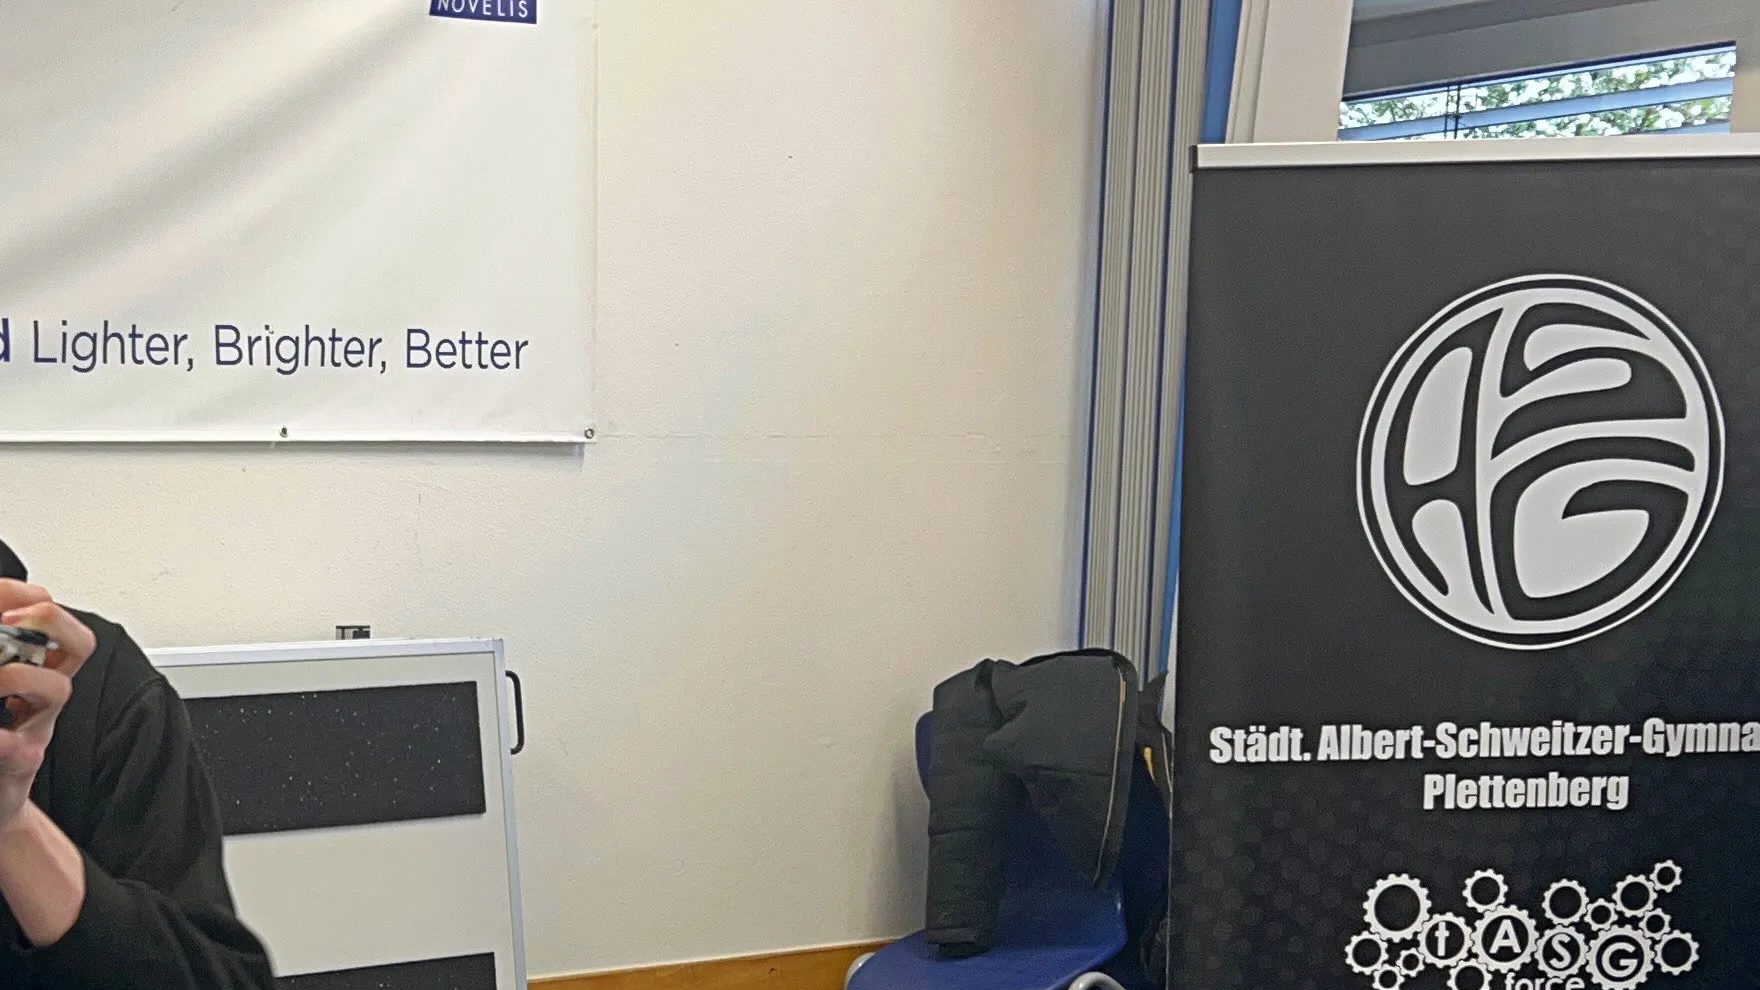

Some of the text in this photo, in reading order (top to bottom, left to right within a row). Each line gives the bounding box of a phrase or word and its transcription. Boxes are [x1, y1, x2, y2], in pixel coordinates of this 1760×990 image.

[33, 320, 195, 373] Lighter,
[215, 324, 387, 375] Brighter,
[405, 328, 529, 371] Better
[1209, 725, 1312, 765] Städt.
[1423, 771, 1630, 811] Plettenberg
